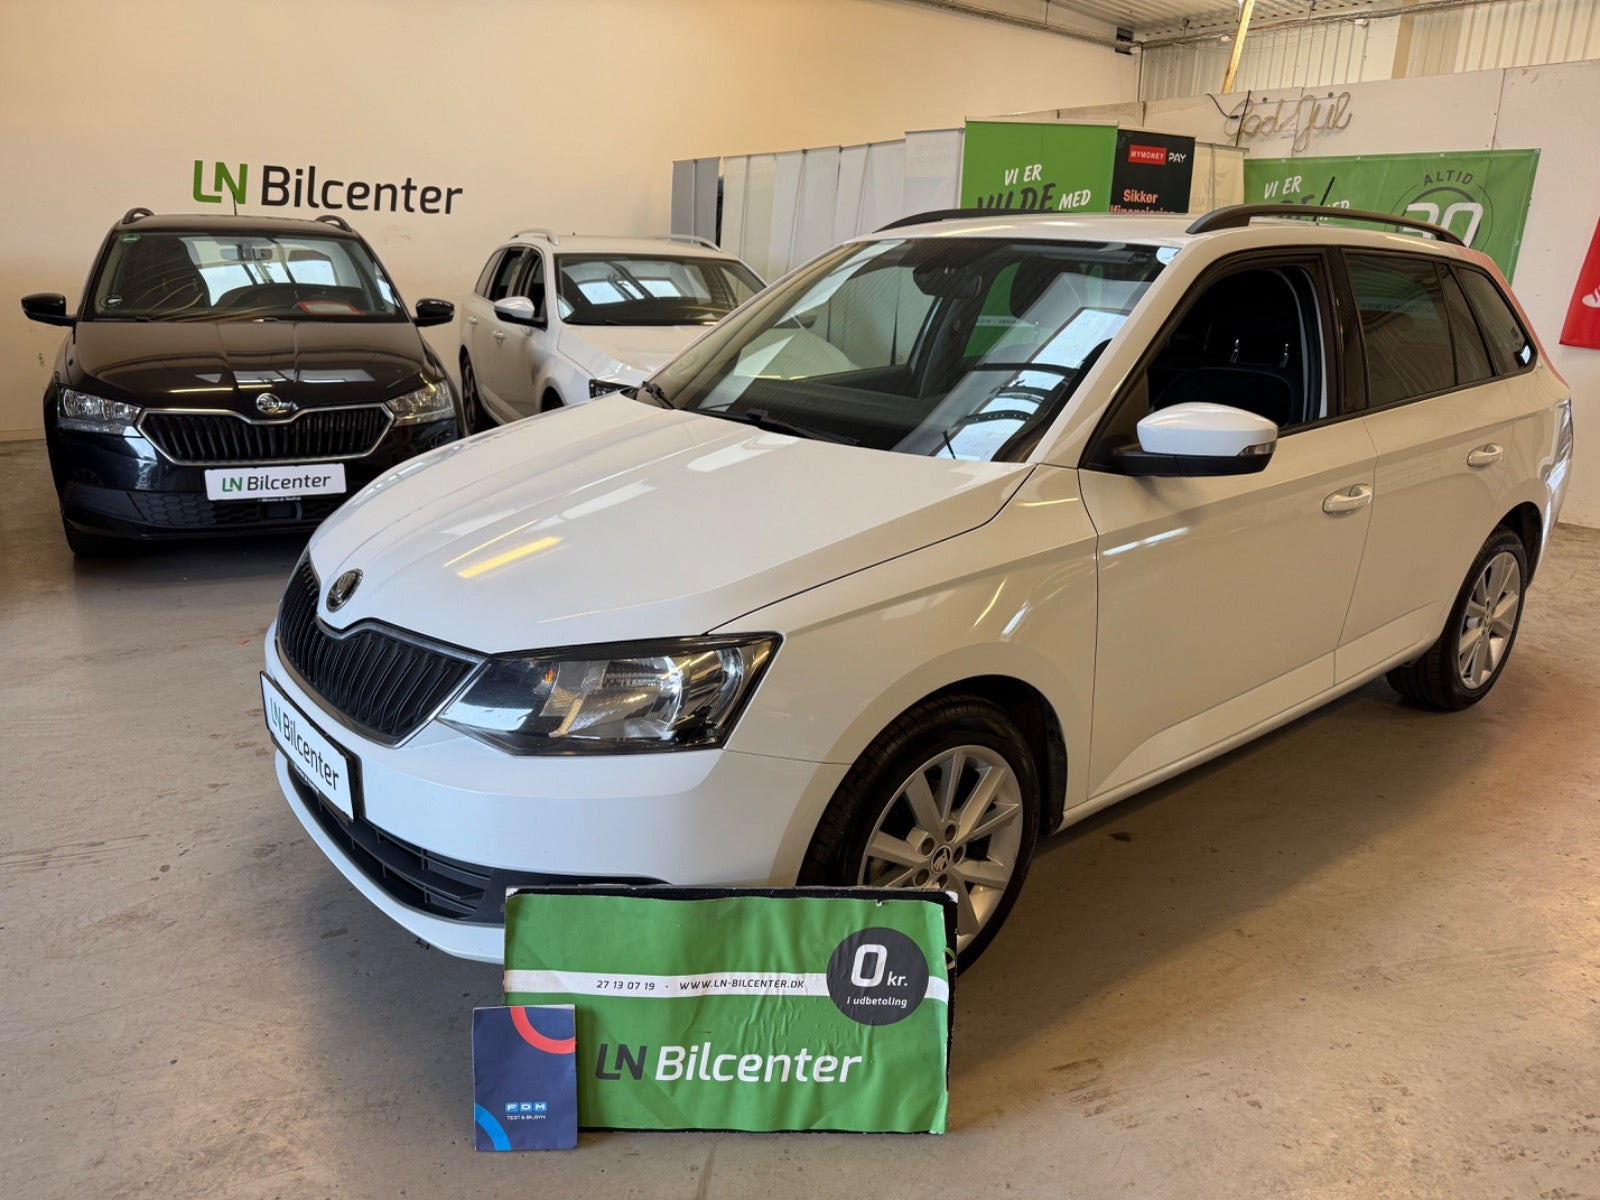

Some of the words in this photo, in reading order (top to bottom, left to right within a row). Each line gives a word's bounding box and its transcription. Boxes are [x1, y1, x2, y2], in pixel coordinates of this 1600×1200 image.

[1130, 150, 1165, 161] MYMONEY
[1168, 152, 1187, 164] PAY
[1003, 167, 1018, 186] VI
[1023, 163, 1042, 183] ER
[1423, 169, 1474, 186] ALTID
[192, 160, 248, 205] LN
[260, 165, 463, 214] Bilcenter
[1122, 188, 1159, 205] Sikker
[1263, 181, 1279, 200] VI
[1282, 175, 1303, 195] ER
[1058, 188, 1092, 211] MED
[221, 476, 243, 492] LN
[247, 474, 331, 491] Bilcenter
[269, 697, 282, 733] LN
[283, 712, 340, 790] Bilcenter
[851, 944, 888, 988] 0
[886, 971, 909, 987] kr.
[596, 980, 609, 989] 27
[613, 980, 624, 989] 13
[627, 981, 640, 990] 07
[644, 982, 655, 991] 19
[679, 978, 805, 991] WWW.LN-BILCENTER.DK
[853, 996, 908, 1009] udbetaling
[594, 1043, 647, 1081] LN
[655, 1041, 862, 1083] Bilcenter
[506, 1102, 547, 1111] FDM
